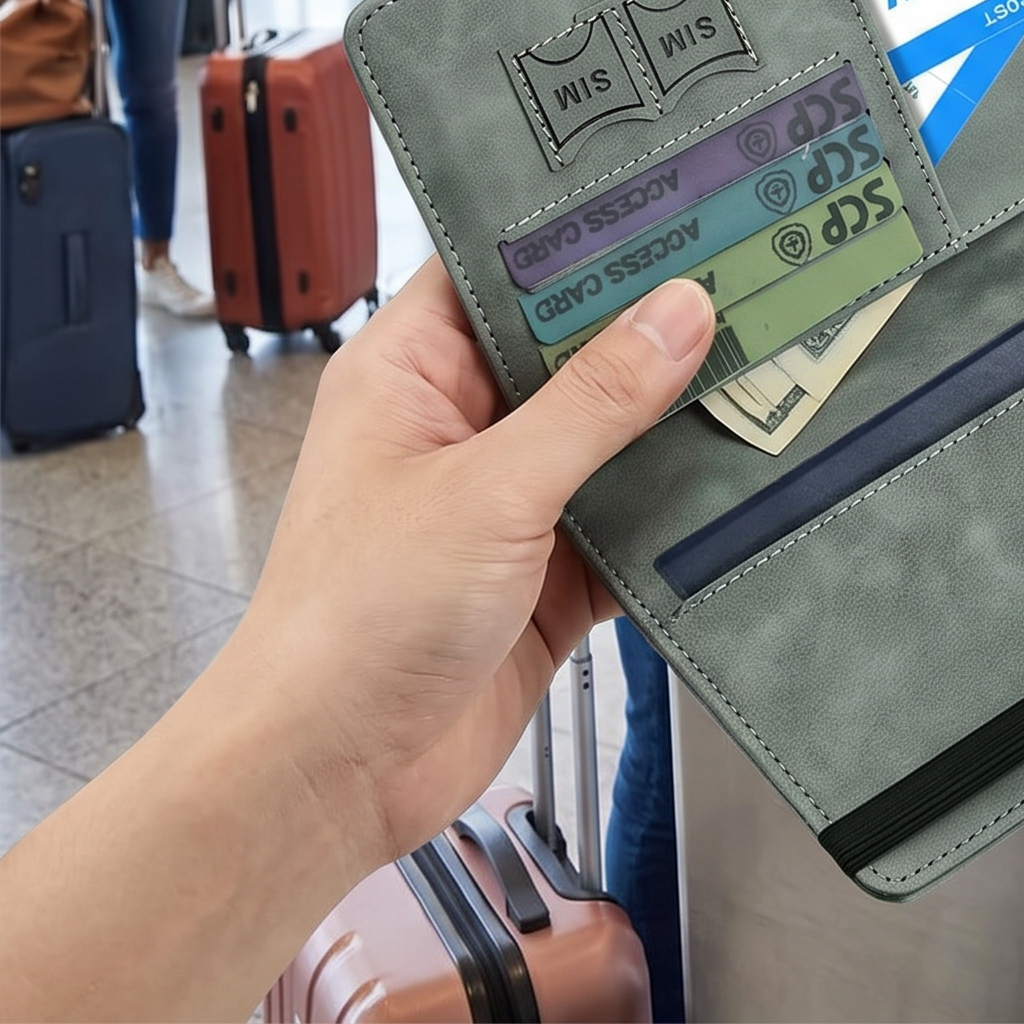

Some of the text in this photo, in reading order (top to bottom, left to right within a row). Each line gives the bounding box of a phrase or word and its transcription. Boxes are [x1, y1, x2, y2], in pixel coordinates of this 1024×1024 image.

[660, 16, 717, 58] SIM
[554, 69, 612, 111] SIM
[788, 77, 862, 143] SCP
[807, 124, 881, 193] SCP
[515, 168, 680, 269] ACCESS CARD
[822, 178, 895, 246] SCP
[536, 218, 700, 322] ACCESS CARD
